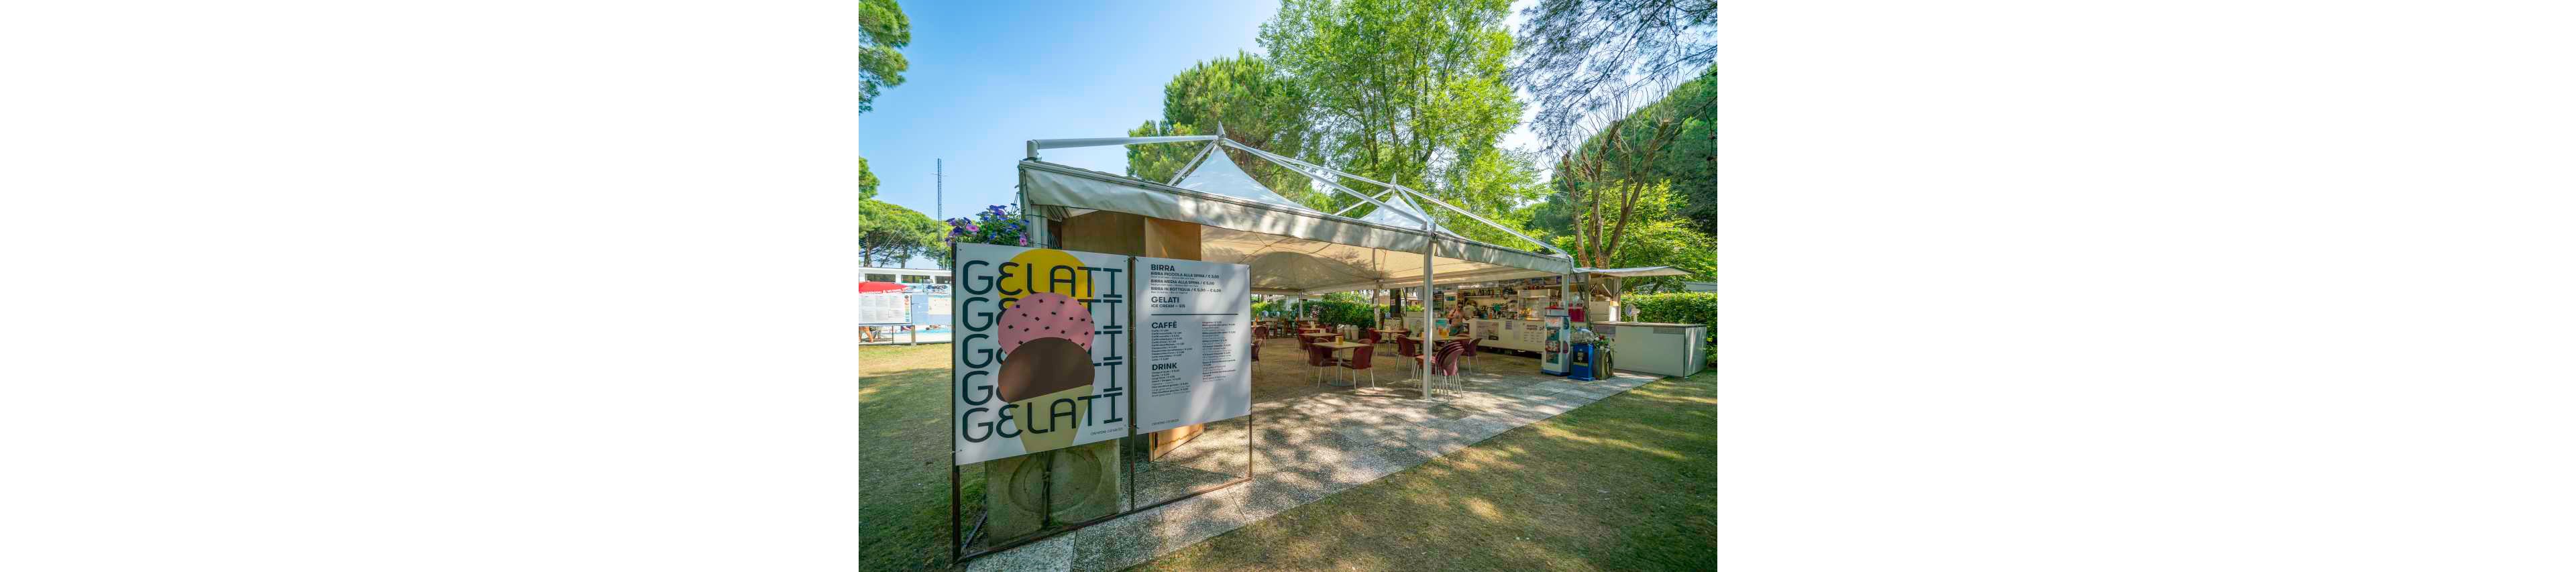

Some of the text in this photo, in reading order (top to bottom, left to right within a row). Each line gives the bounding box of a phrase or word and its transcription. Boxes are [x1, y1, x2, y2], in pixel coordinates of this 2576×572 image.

[962, 260, 1122, 298] GELATI
[1151, 264, 1175, 272] BIRRA
[1152, 363, 1177, 371] DRINK
[962, 392, 1123, 443] GELATI
